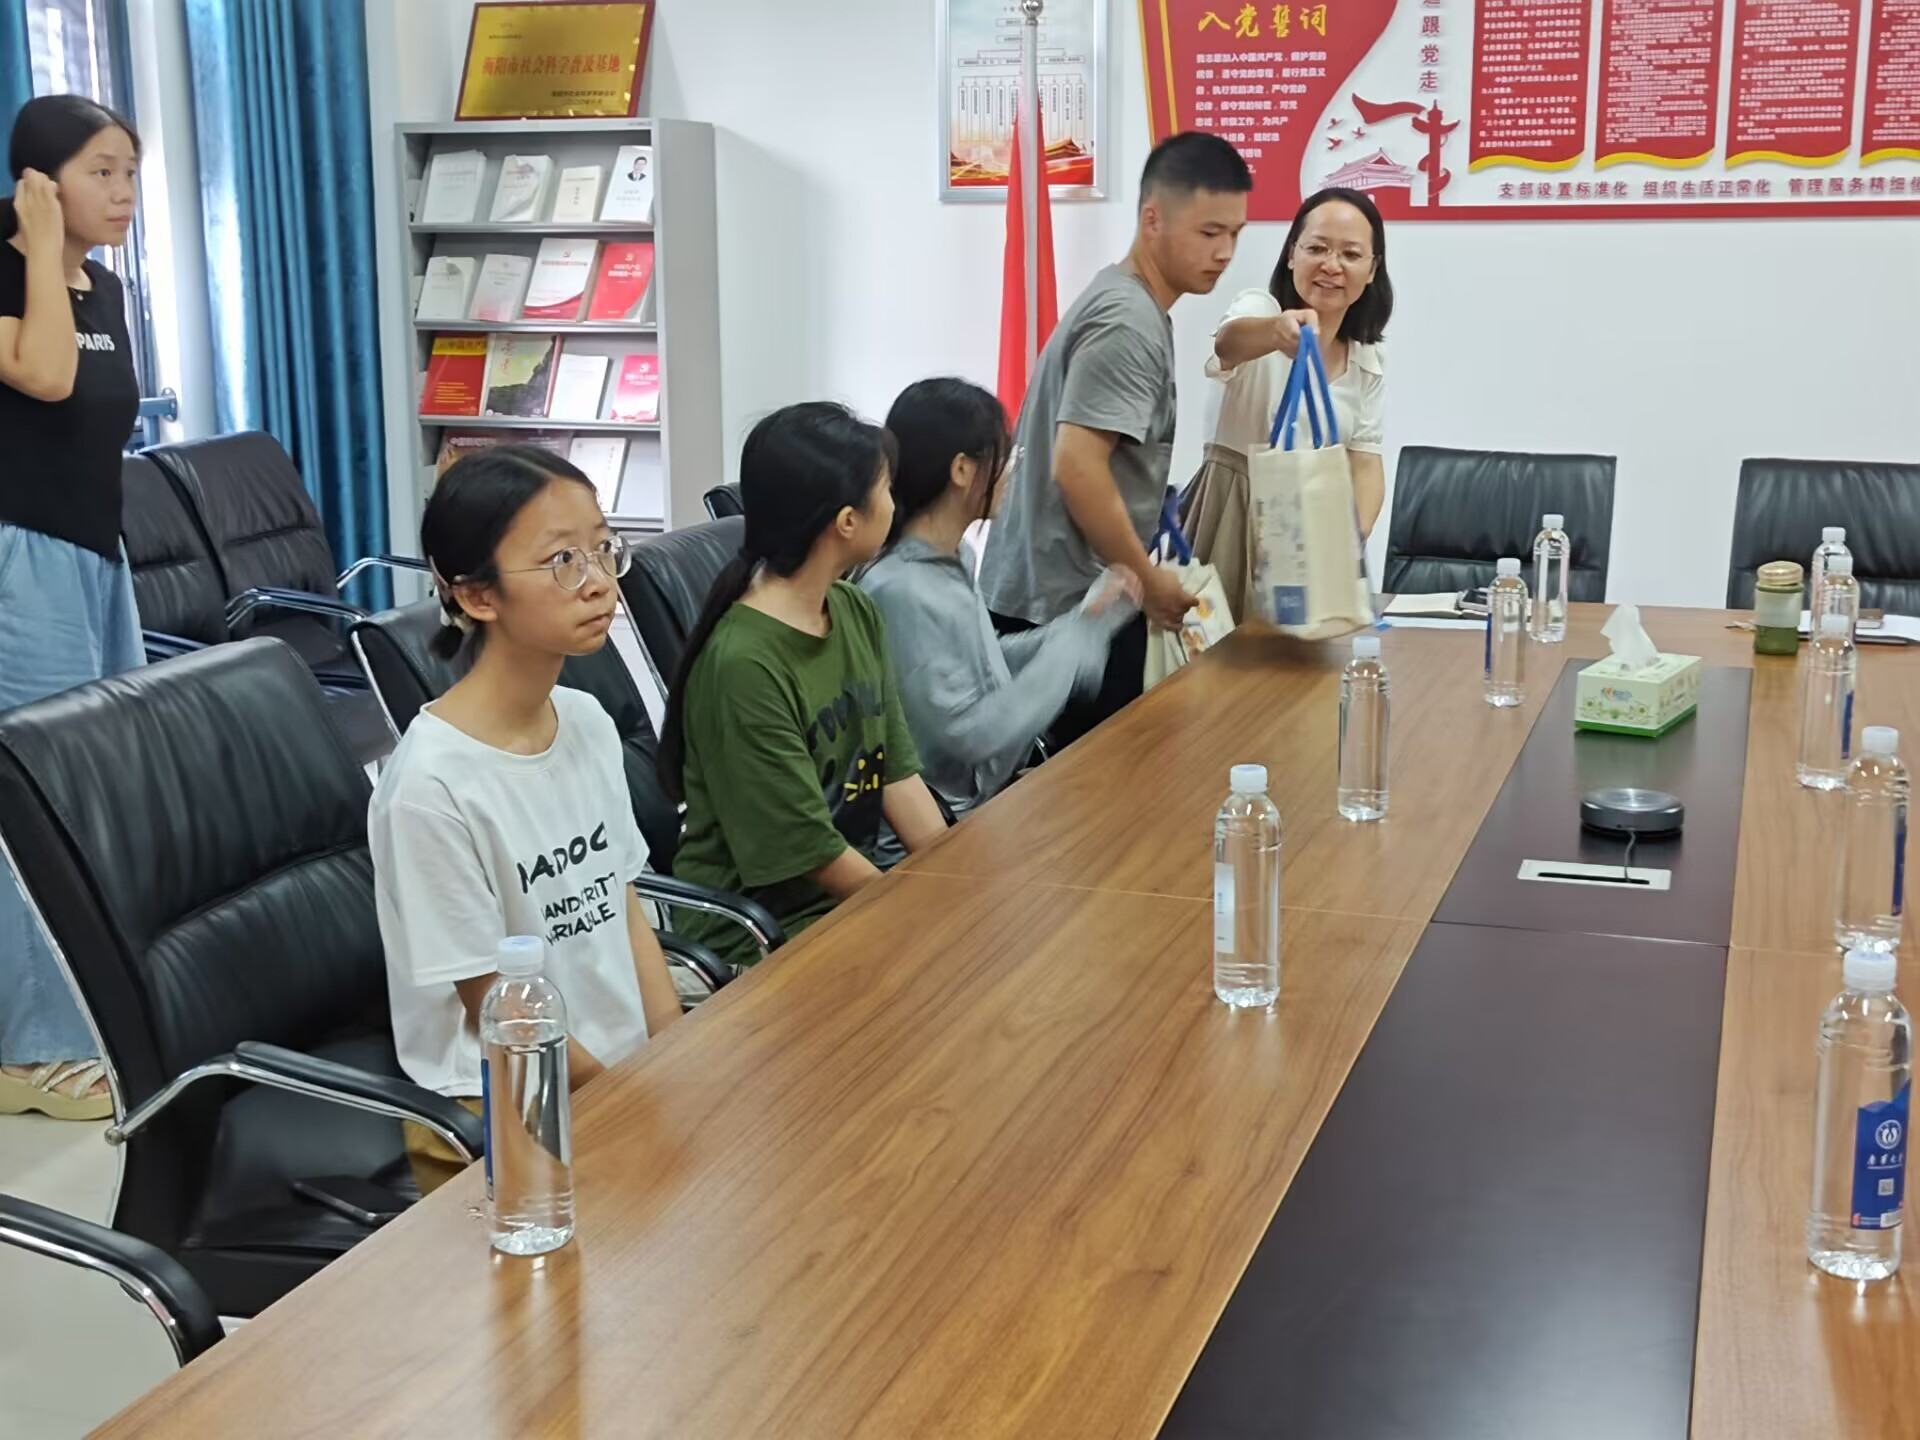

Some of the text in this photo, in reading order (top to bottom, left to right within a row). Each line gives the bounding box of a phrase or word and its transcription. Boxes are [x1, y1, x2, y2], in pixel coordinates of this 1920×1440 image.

[1198, 3, 1327, 38] 入党誓词
[1499, 181, 1628, 196] 支部设置标准化
[1643, 180, 1771, 196] 组织生活正常化
[75, 332, 115, 351] PARIS
